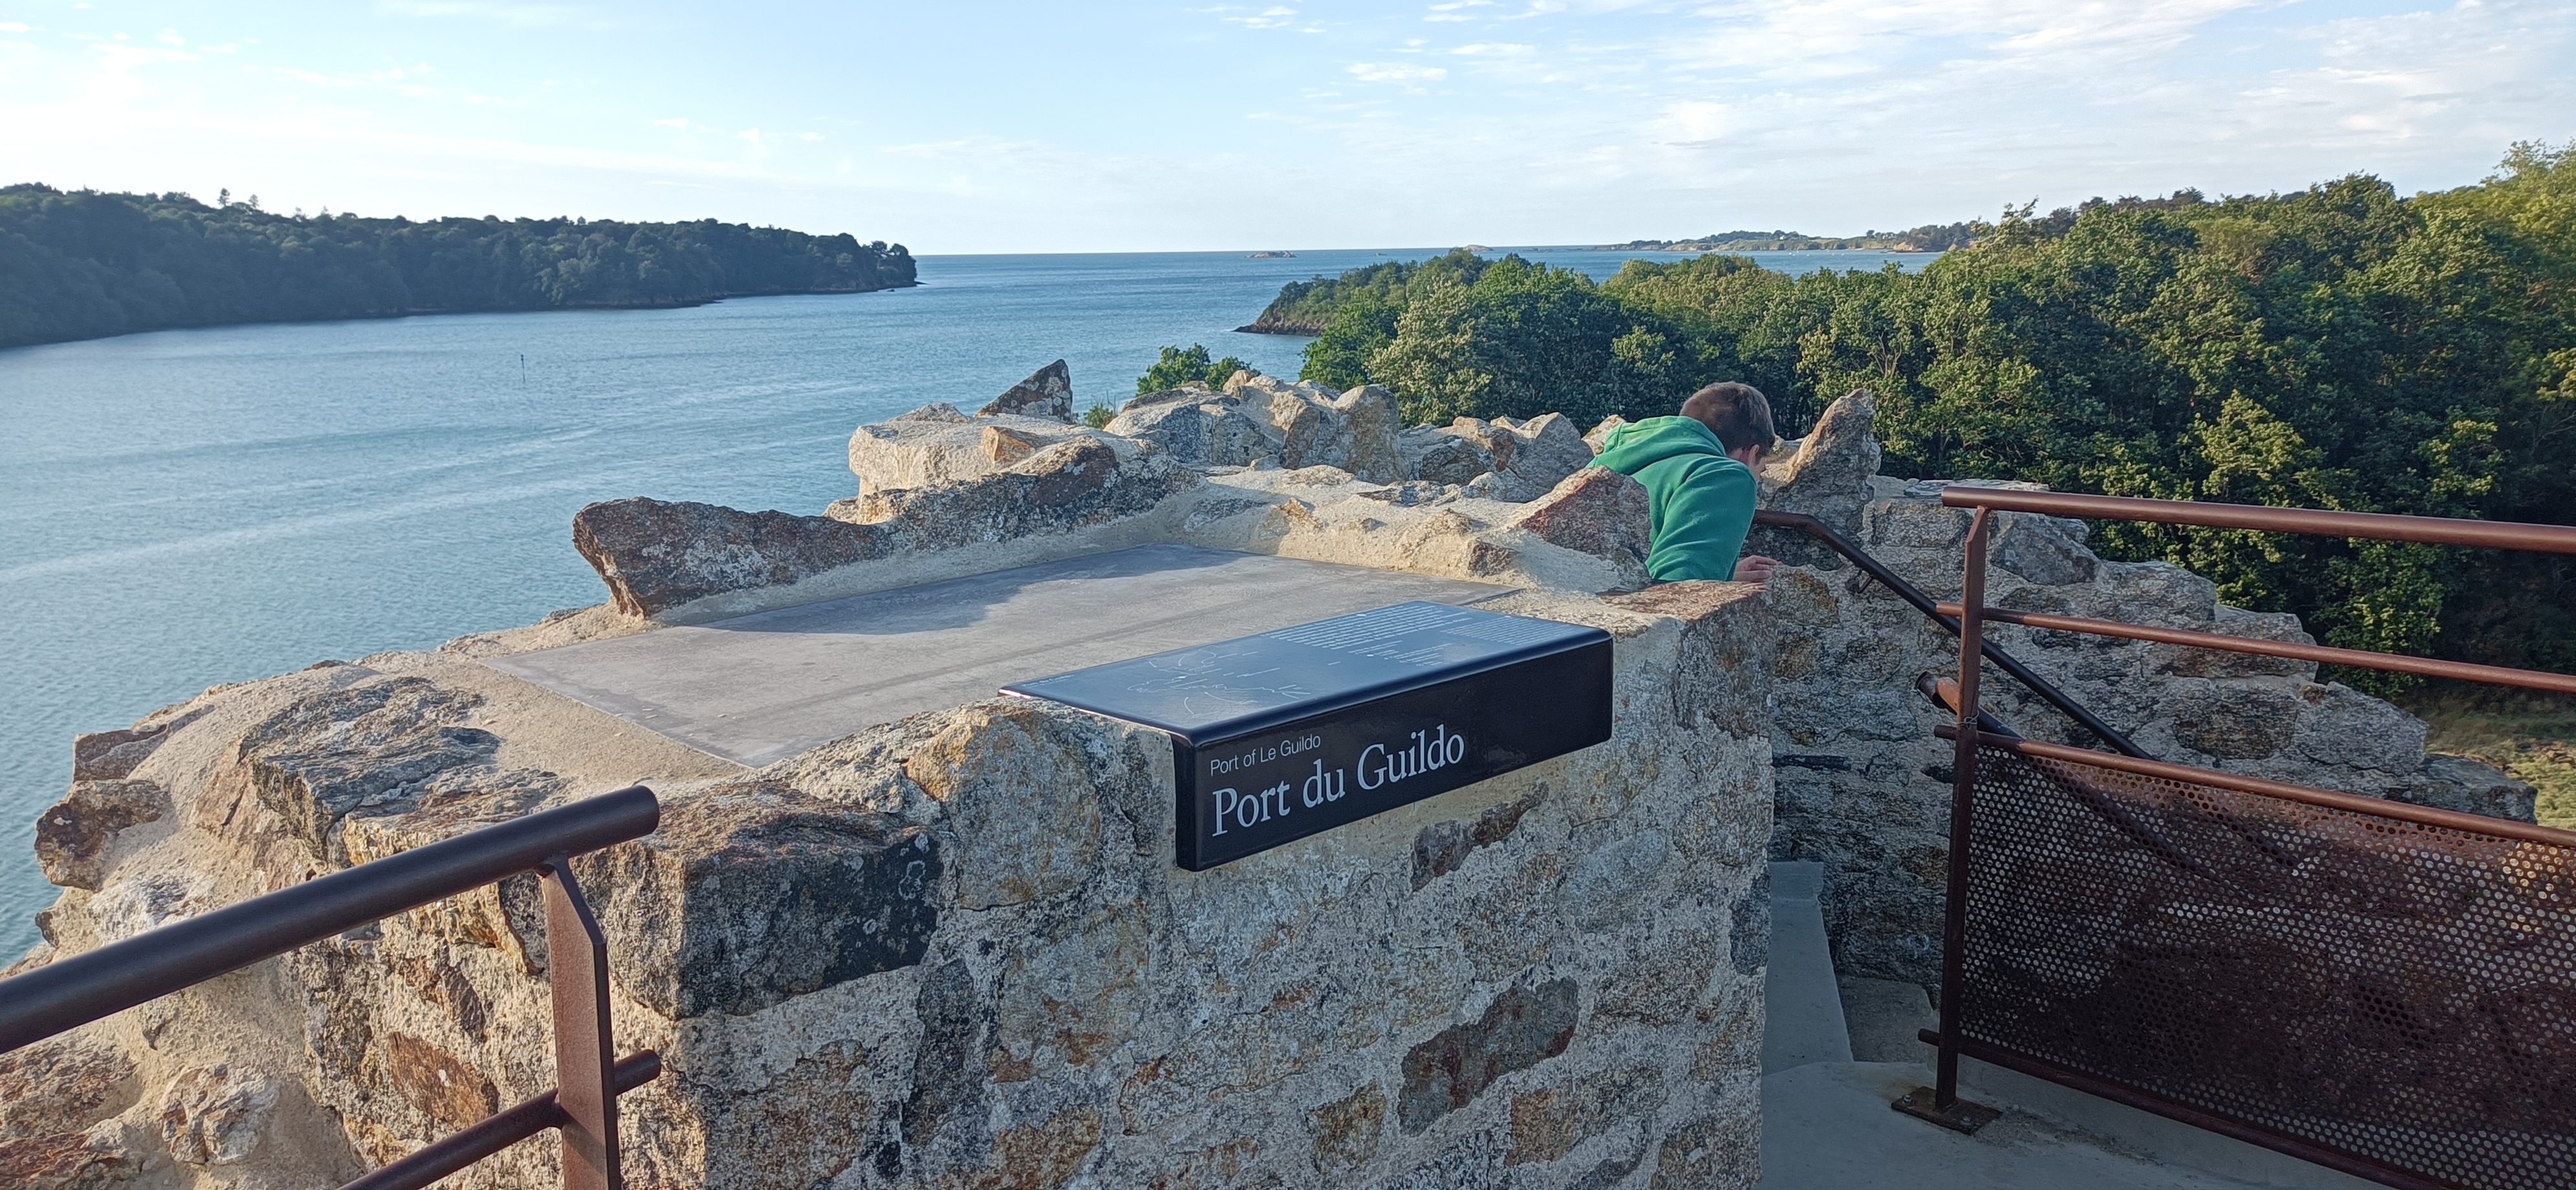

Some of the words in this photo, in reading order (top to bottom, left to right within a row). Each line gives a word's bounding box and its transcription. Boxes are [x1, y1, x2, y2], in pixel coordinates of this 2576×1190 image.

[1210, 755, 1239, 776] Port
[1243, 749, 1256, 767] of
[1261, 746, 1276, 763] Le
[1280, 733, 1321, 757] Guildo
[1212, 780, 1291, 837] Port
[1303, 759, 1346, 808] du
[1357, 724, 1465, 790] Guildo
